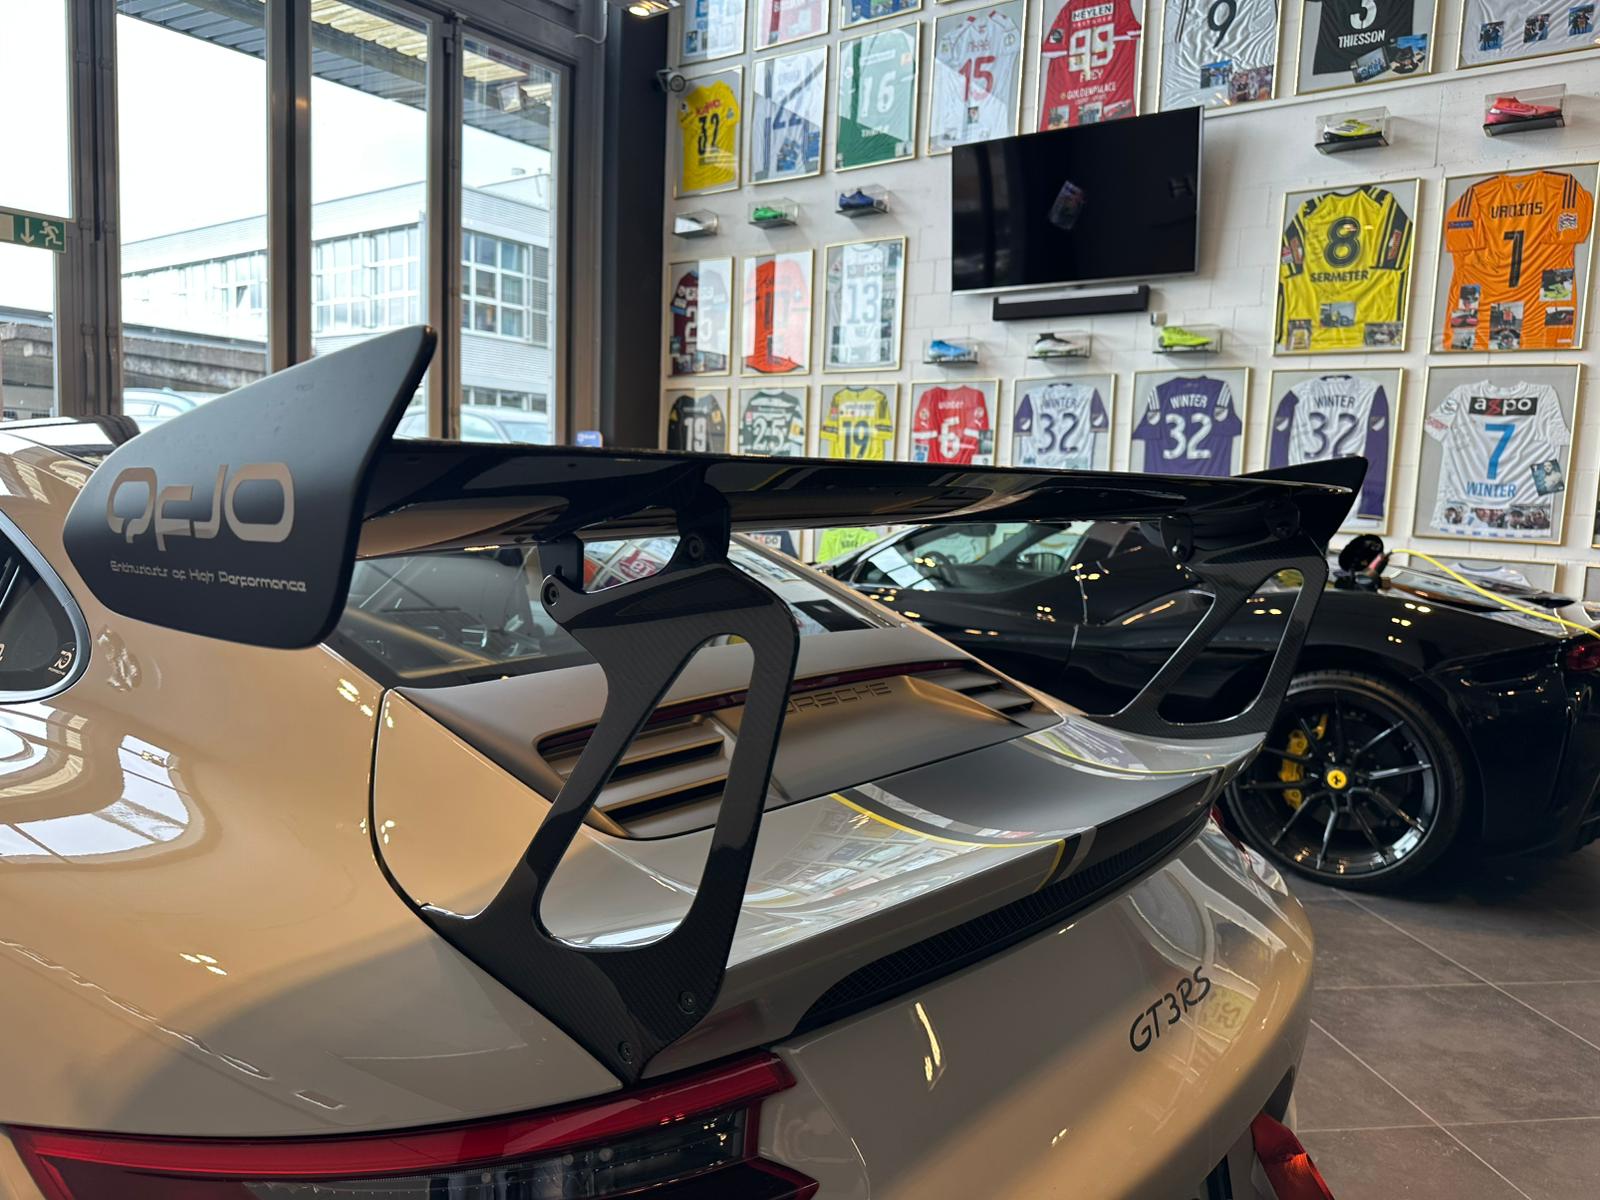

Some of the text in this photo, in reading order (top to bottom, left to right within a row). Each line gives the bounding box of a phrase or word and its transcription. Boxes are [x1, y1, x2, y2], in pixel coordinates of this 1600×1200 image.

[1069, 23, 1115, 81] 99
[1338, 30, 1385, 48] THIESSON
[862, 71, 896, 117] 16
[959, 55, 995, 101] 15
[1324, 216, 1361, 268] 8
[1310, 269, 1369, 283] SERMETER
[1169, 394, 1208, 409] WINTER
[1313, 395, 1355, 409] WINTER
[684, 418, 707, 452] 19
[842, 420, 871, 459] 19
[940, 416, 961, 459] 6
[1038, 413, 1079, 453] 32
[1163, 413, 1212, 459] 32
[1303, 412, 1360, 459] 32
[1485, 423, 1516, 480] 7
[1466, 480, 1517, 498] WINTER
